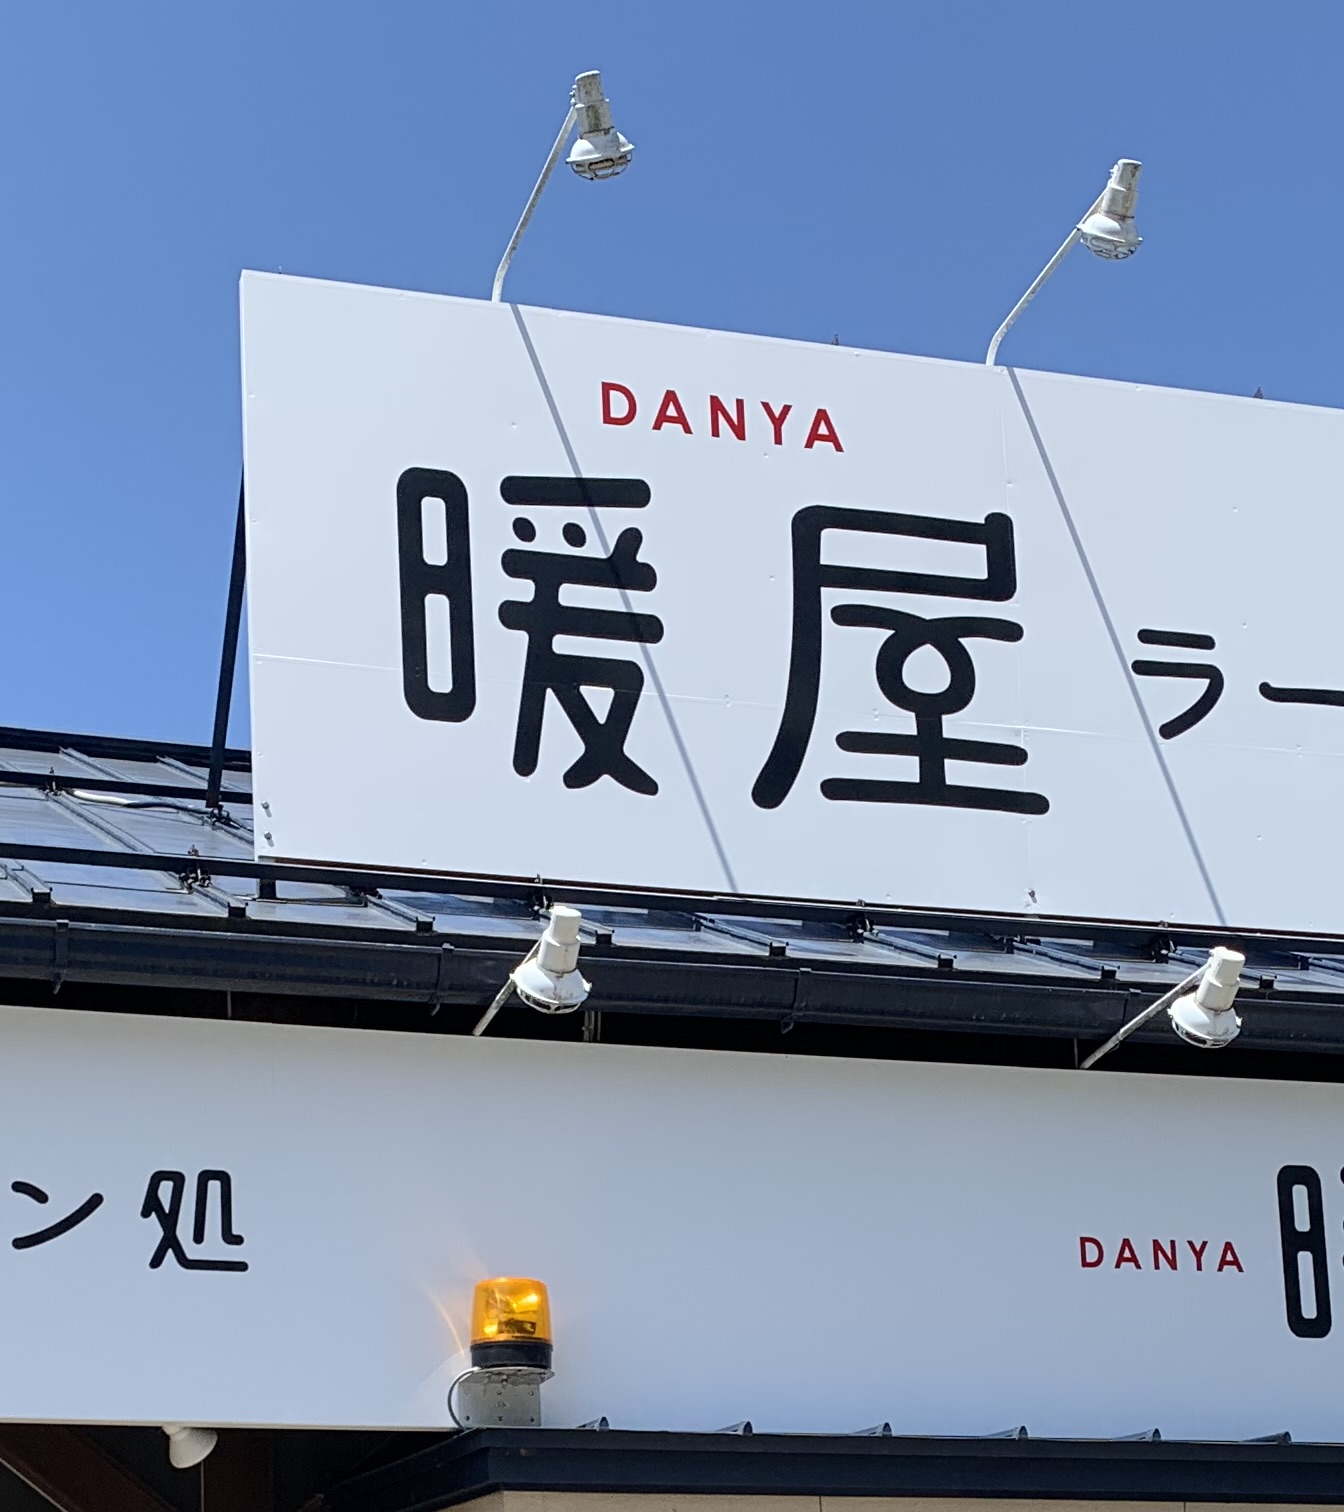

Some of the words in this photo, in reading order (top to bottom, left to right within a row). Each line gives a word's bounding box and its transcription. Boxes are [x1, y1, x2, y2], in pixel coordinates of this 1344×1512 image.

[600, 381, 844, 453] DANYA
[396, 466, 1051, 816] 暖屋
[1079, 1236, 1244, 1273] DANYA
